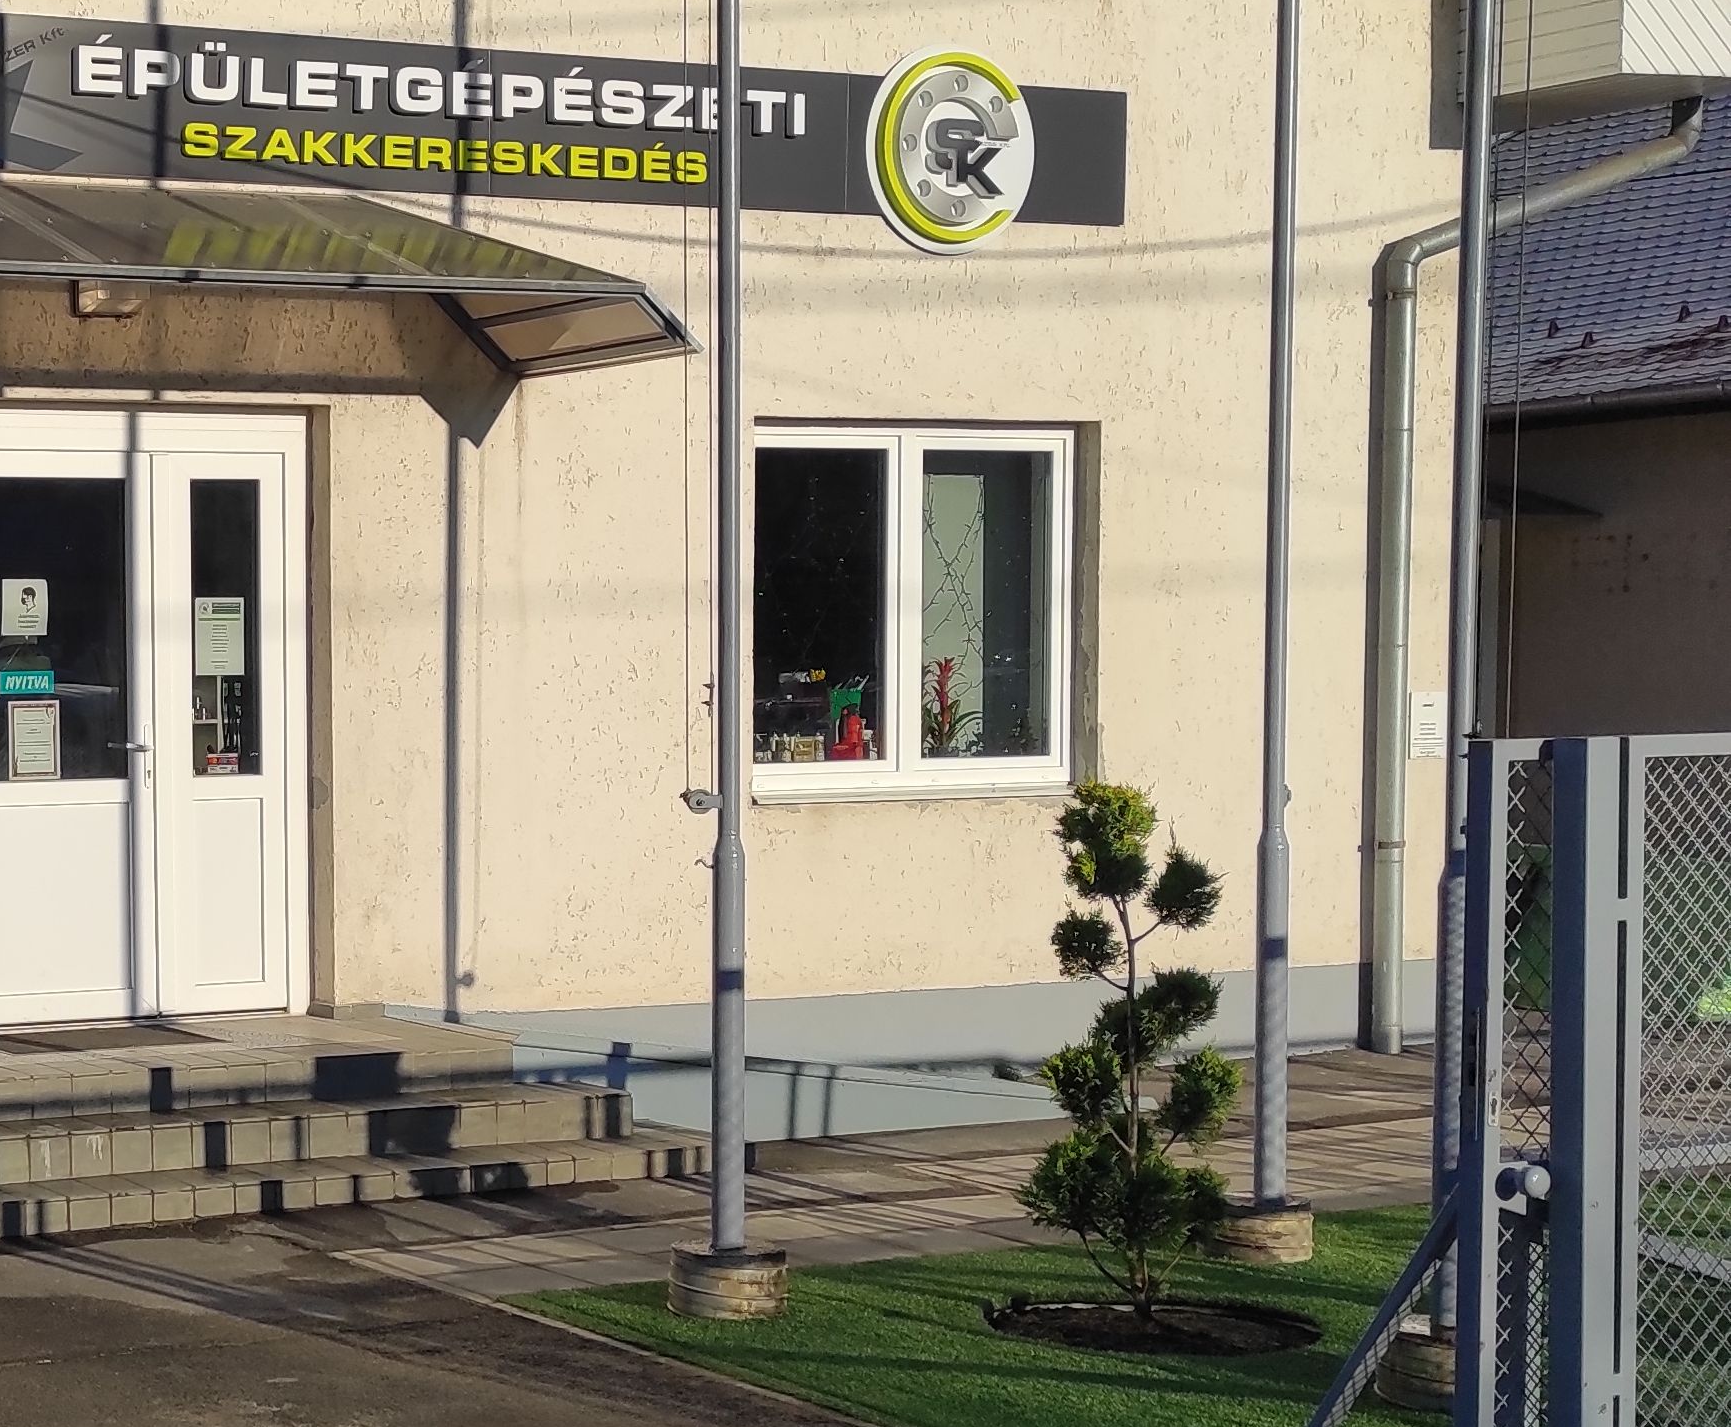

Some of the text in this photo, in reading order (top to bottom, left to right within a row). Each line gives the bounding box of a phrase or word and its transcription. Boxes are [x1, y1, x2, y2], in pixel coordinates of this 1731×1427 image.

[0, 39, 36, 62] ZER
[183, 122, 708, 184] SZAKKERESKEDÉS
[5, 675, 49, 690] NYITVA
